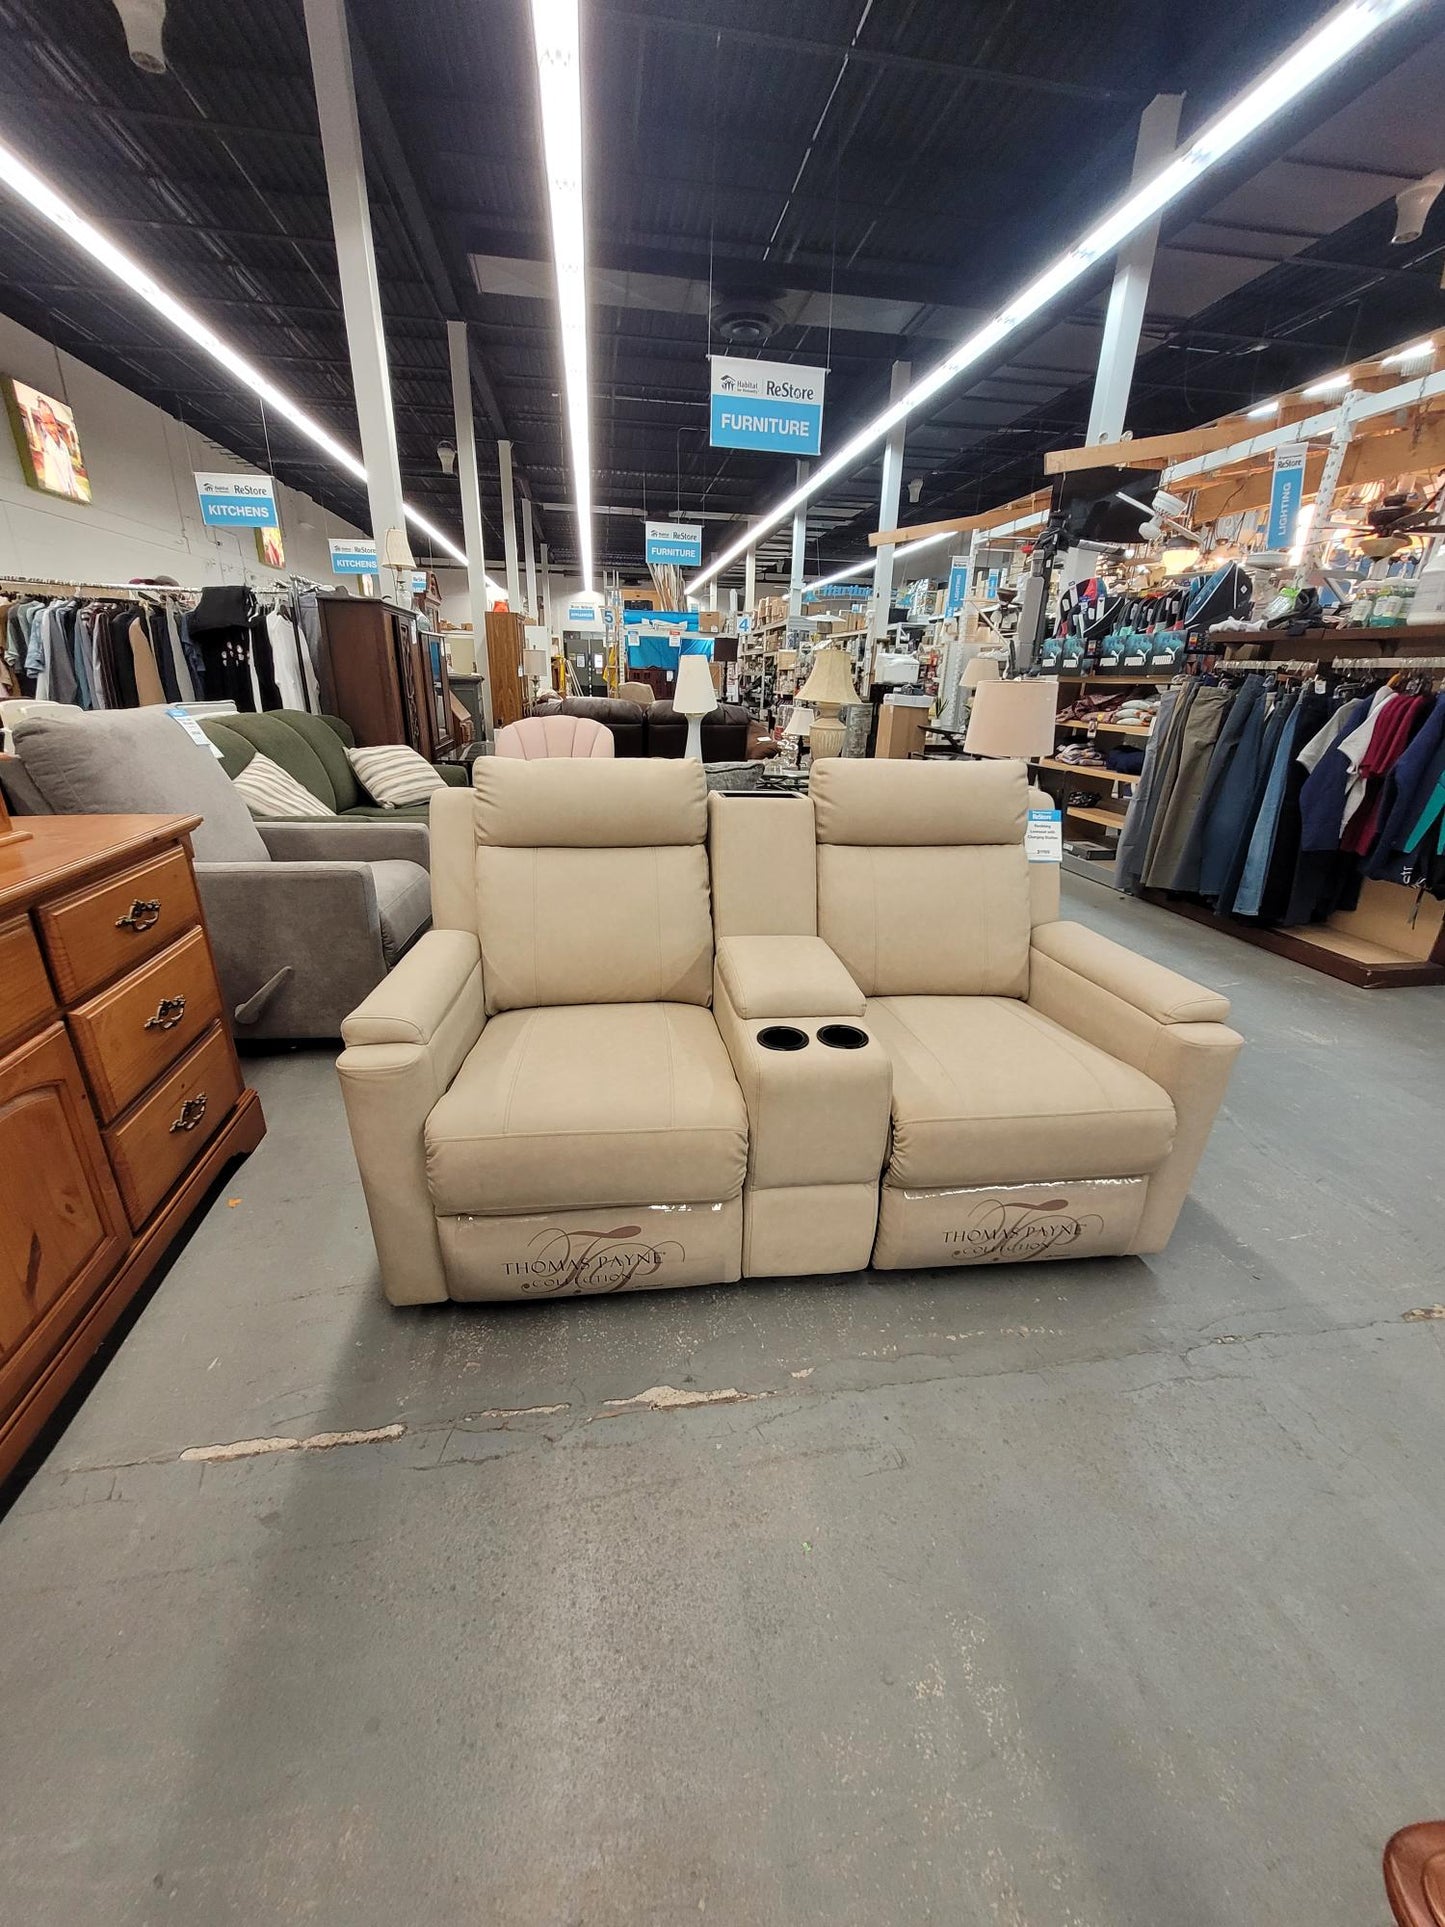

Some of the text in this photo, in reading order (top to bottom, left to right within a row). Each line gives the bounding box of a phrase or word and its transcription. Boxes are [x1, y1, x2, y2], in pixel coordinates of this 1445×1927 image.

[737, 380, 814, 400] Habitat ReStore
[721, 413, 810, 437] FURNITURE
[1278, 460, 1301, 468] ReStore
[233, 484, 267, 495] ReStore
[208, 504, 269, 518] KITCHENS
[1278, 482, 1292, 535] LIGHTING
[672, 531, 697, 540] ReStore
[651, 547, 696, 557] FURNITURE
[336, 559, 377, 569] KITCHENS
[604, 611, 613, 623] 5
[739, 618, 749, 631] 4
[942, 1223, 1081, 1243] THOMAS PAYNE
[501, 1251, 663, 1275] THOMAS PAYNE
